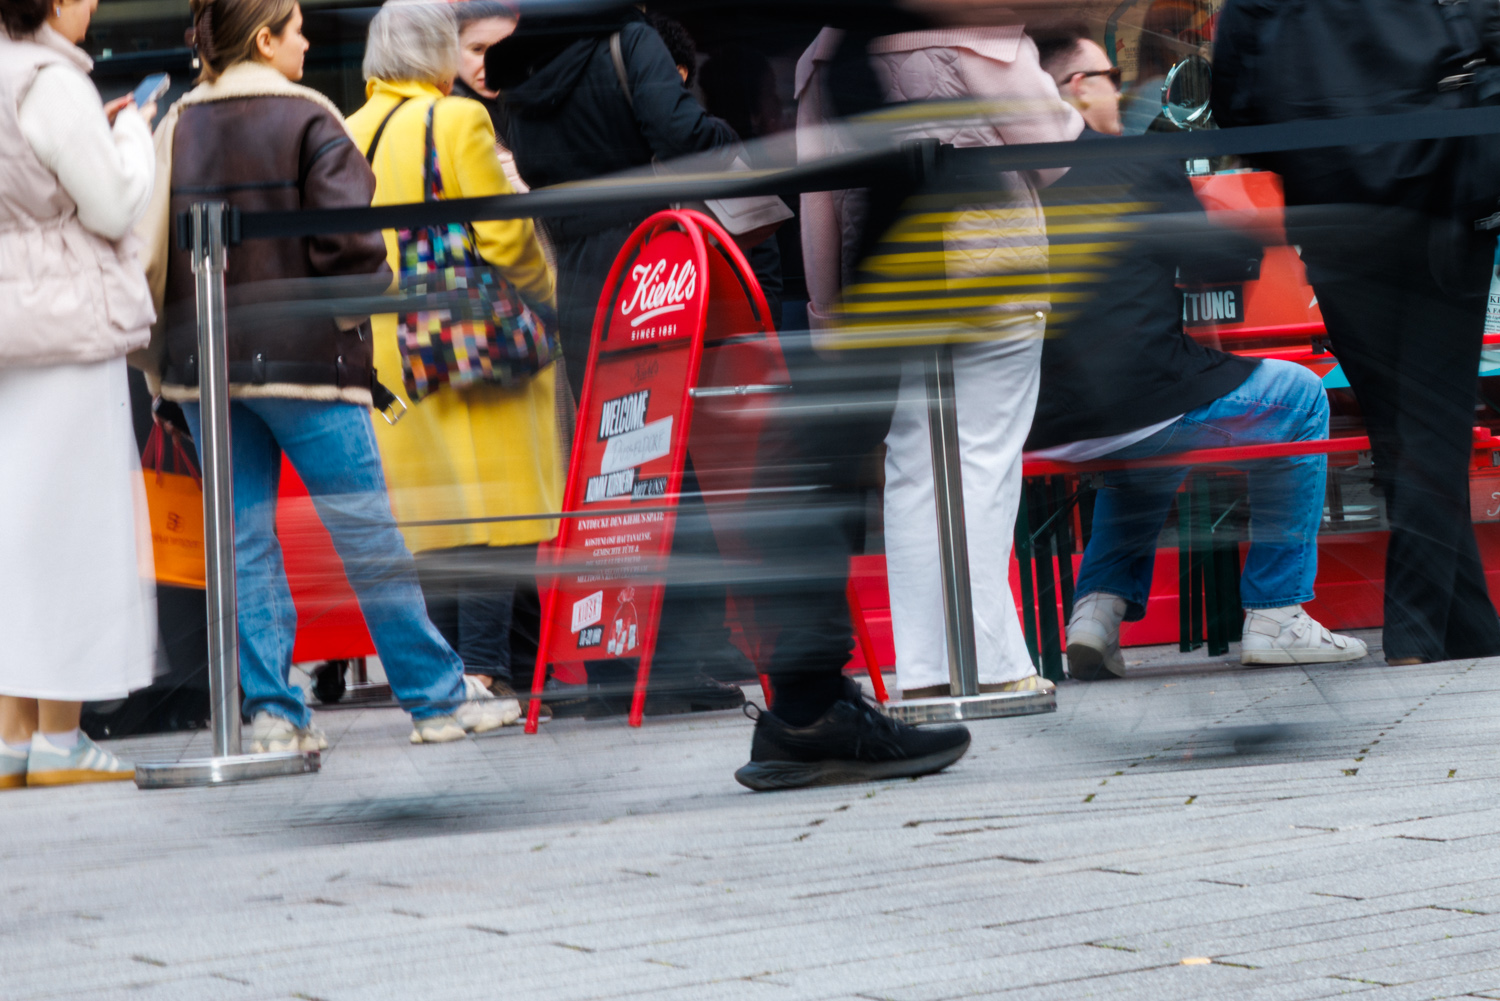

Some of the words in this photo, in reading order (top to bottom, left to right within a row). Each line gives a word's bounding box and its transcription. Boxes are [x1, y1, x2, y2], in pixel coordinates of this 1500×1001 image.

[622, 259, 697, 315] Kiehl's
[1183, 290, 1236, 322] TUNG
[632, 327, 655, 341] SINCE
[658, 324, 677, 337] 1851
[600, 390, 648, 438] WELCOME
